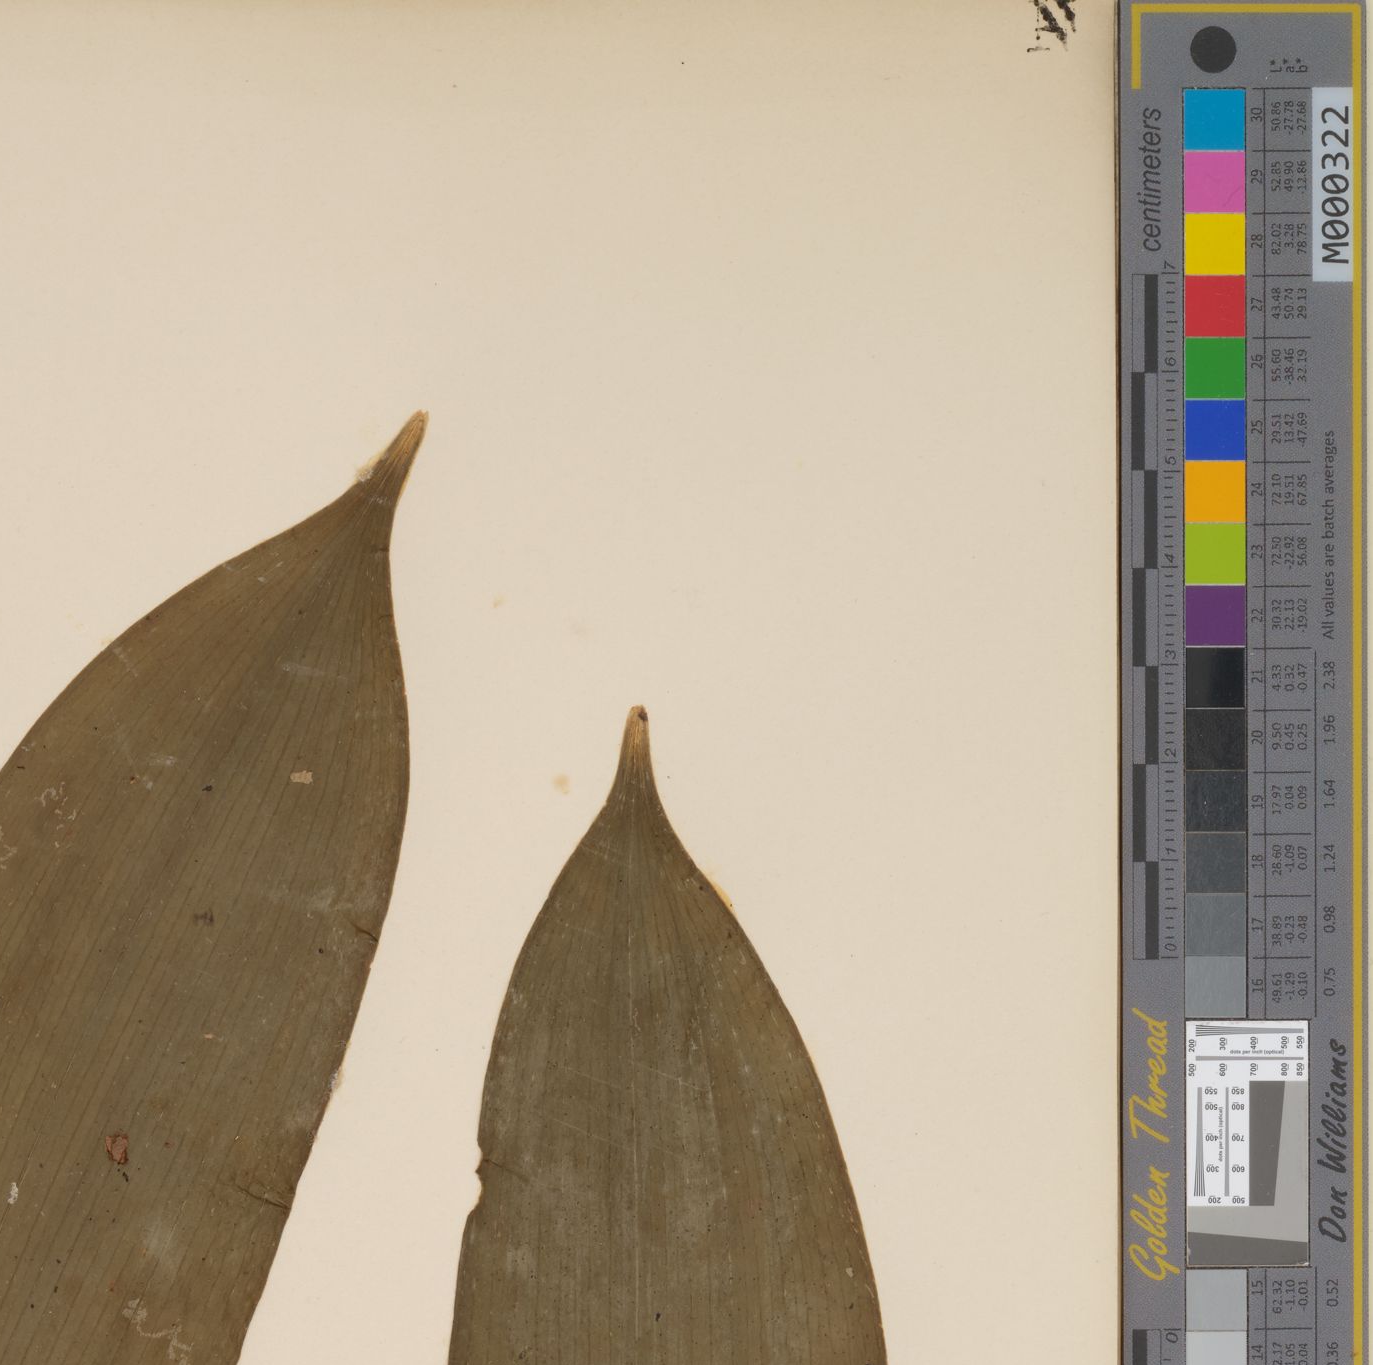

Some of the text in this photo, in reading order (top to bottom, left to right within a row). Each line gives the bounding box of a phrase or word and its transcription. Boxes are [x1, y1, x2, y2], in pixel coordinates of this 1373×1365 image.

[1251, 108, 1262, 122] 30
[1137, 108, 1161, 251] centimeters
[1251, 169, 1262, 183] 29
[1322, 106, 1349, 264] M000322
[1251, 234, 1263, 248] 28
[1251, 298, 1262, 311] 27
[1251, 355, 1263, 368] 26
[1251, 420, 1263, 434] 25
[1251, 483, 1262, 496] 24
[1321, 431, 1337, 639] All values are batch averages
[1251, 545, 1263, 558] 23
[1251, 609, 1263, 622] 22
[1251, 670, 1263, 683] 21
[1323, 662, 1335, 689] 2.38
[1323, 715, 1335, 744] 1.96
[1251, 730, 1263, 744] 20
[1322, 780, 1335, 808] 1.64
[1251, 795, 1263, 809] 19
[1252, 855, 1263, 868] 18
[1323, 845, 1335, 872] 1.24
[1252, 918, 1263, 931] 17
[1323, 906, 1335, 933] 0.98
[1252, 979, 1263, 993] 16
[1324, 968, 1335, 996] 0.75
[1128, 1007, 1180, 1281] Golden Thread
[1317, 1038, 1347, 1242] Don Williams
[1252, 1281, 1263, 1295] 15
[1326, 1279, 1338, 1307] 0.52
[1251, 1345, 1263, 1360] 14
